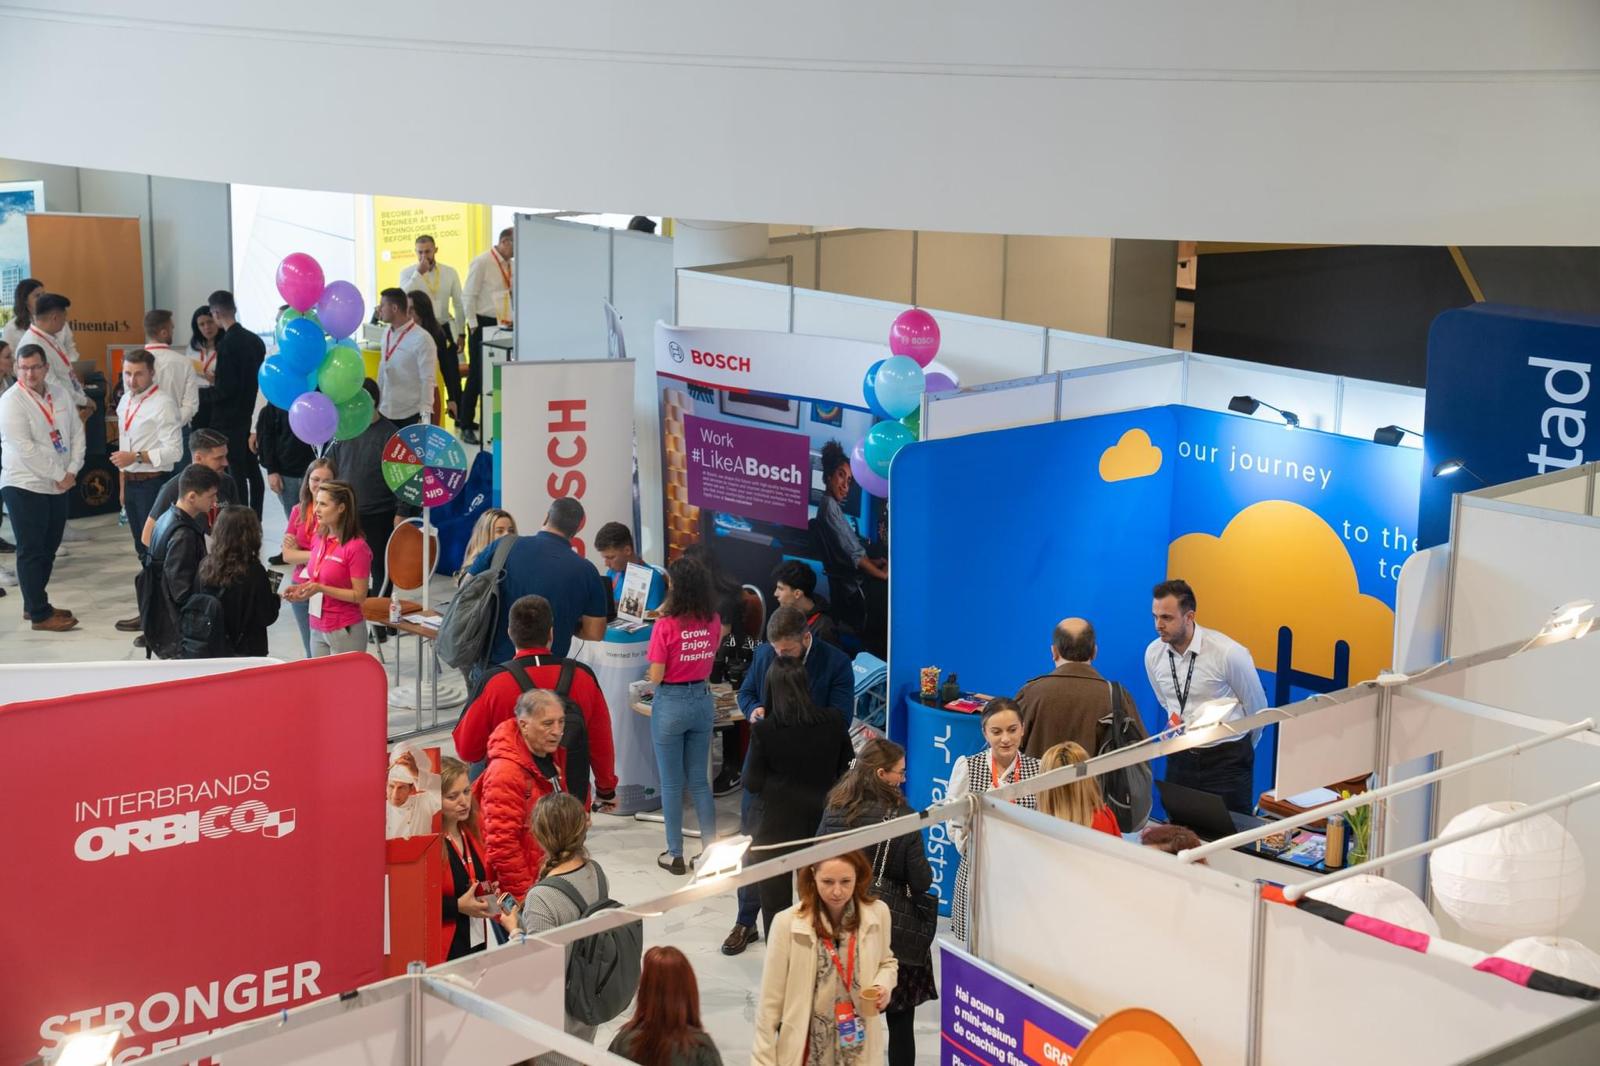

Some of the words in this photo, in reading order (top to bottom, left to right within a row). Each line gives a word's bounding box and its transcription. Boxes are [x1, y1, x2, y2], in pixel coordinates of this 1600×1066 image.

[381, 210, 412, 218] BECOME
[382, 217, 418, 227] ENGINEER
[420, 215, 428, 223] AT
[431, 214, 460, 222] VITESCO
[382, 224, 437, 235] TECHNOLOGIES
[690, 349, 751, 373] BOSCH
[700, 427, 734, 449] Work
[547, 399, 587, 558] SCH
[691, 447, 802, 485] #LikeABosch
[1178, 441, 1218, 463] our
[1229, 446, 1332, 490] journey
[425, 487, 444, 499] Gift
[1343, 519, 1369, 543] to
[681, 628, 710, 640] Grow.
[681, 638, 711, 652] Enjoy.
[75, 770, 270, 822] INTERBRANDS
[74, 800, 271, 862] ORBICO
[927, 777, 952, 905] radstad
[38, 960, 321, 1056] STRONGER
[955, 984, 969, 1004] Hai
[970, 996, 994, 1019] acum
[995, 1008, 1005, 1024] la
[953, 1021, 964, 1036] de
[965, 1030, 1006, 1063] coaching
[954, 1005, 961, 1016] o
[961, 1009, 1017, 1049] mini-sesiune
